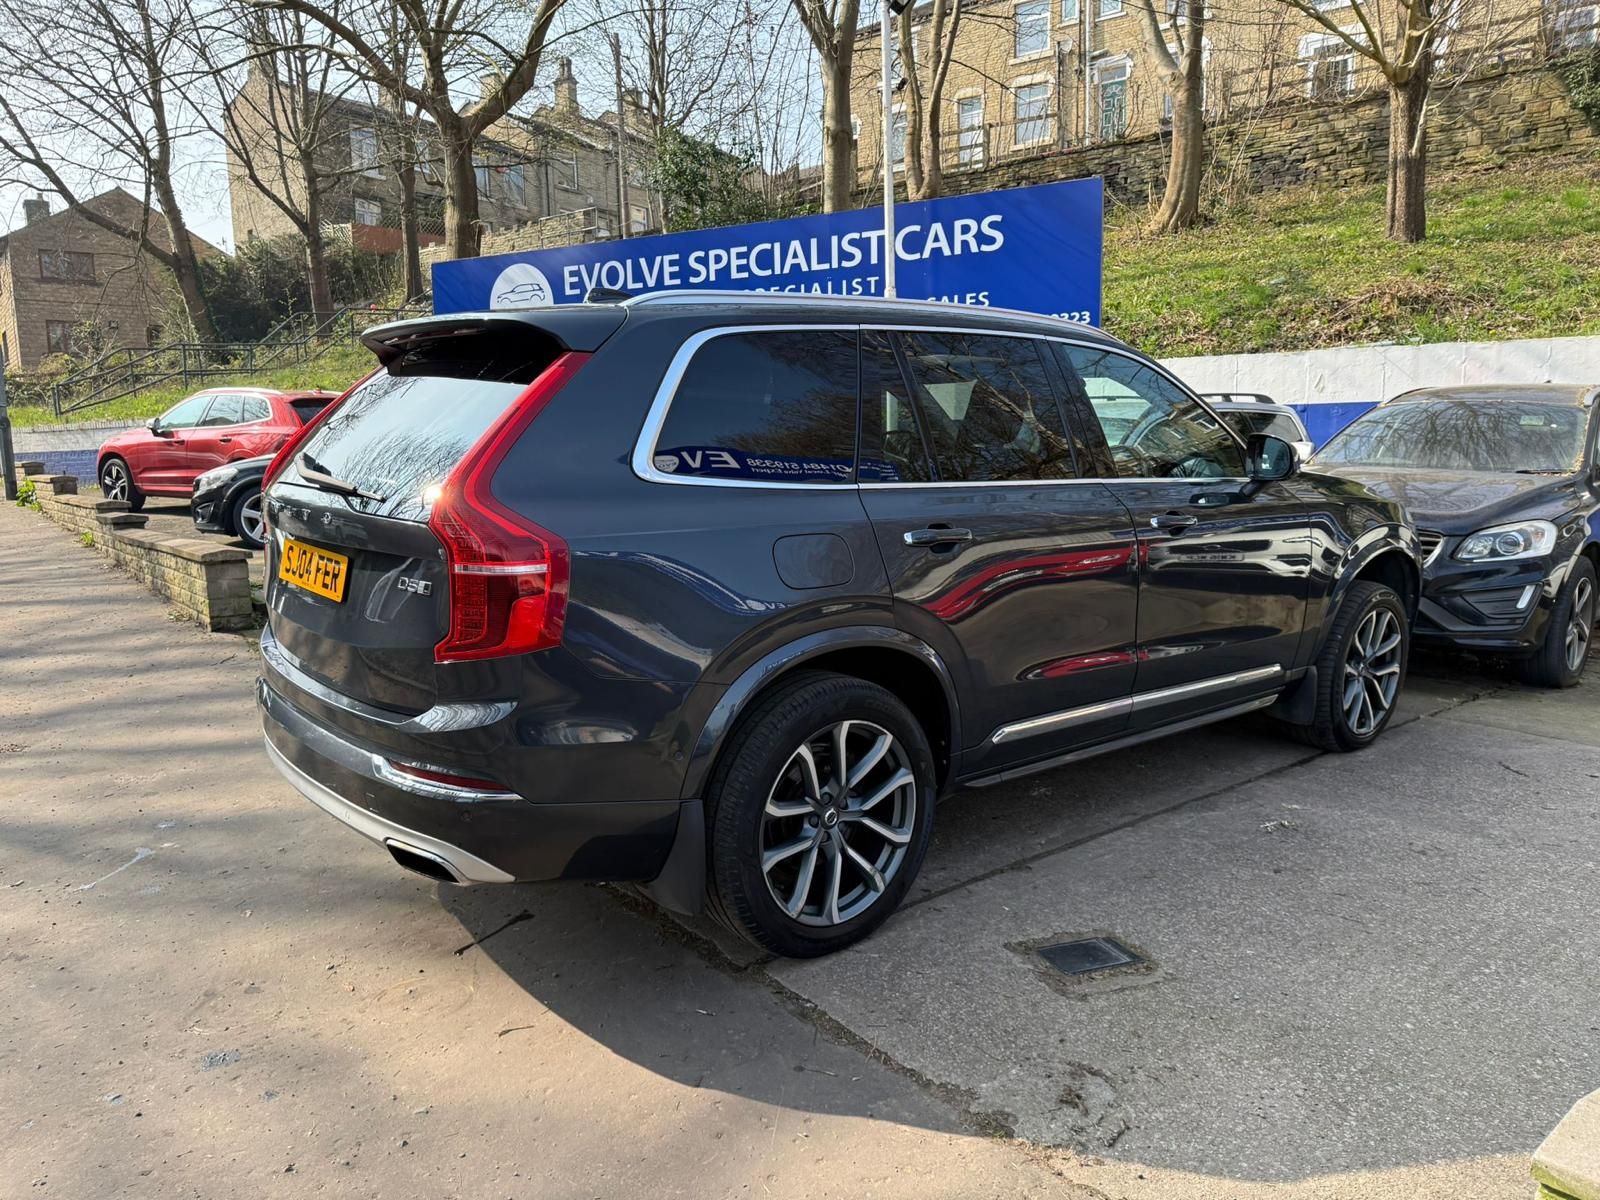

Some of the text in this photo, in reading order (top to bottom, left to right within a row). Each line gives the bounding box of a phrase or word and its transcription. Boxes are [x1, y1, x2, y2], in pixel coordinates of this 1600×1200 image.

[563, 214, 1005, 296] EVOLVE SPECIALIST CARS
[744, 276, 880, 296] CIALIST
[285, 545, 342, 593] SJ04 FER
